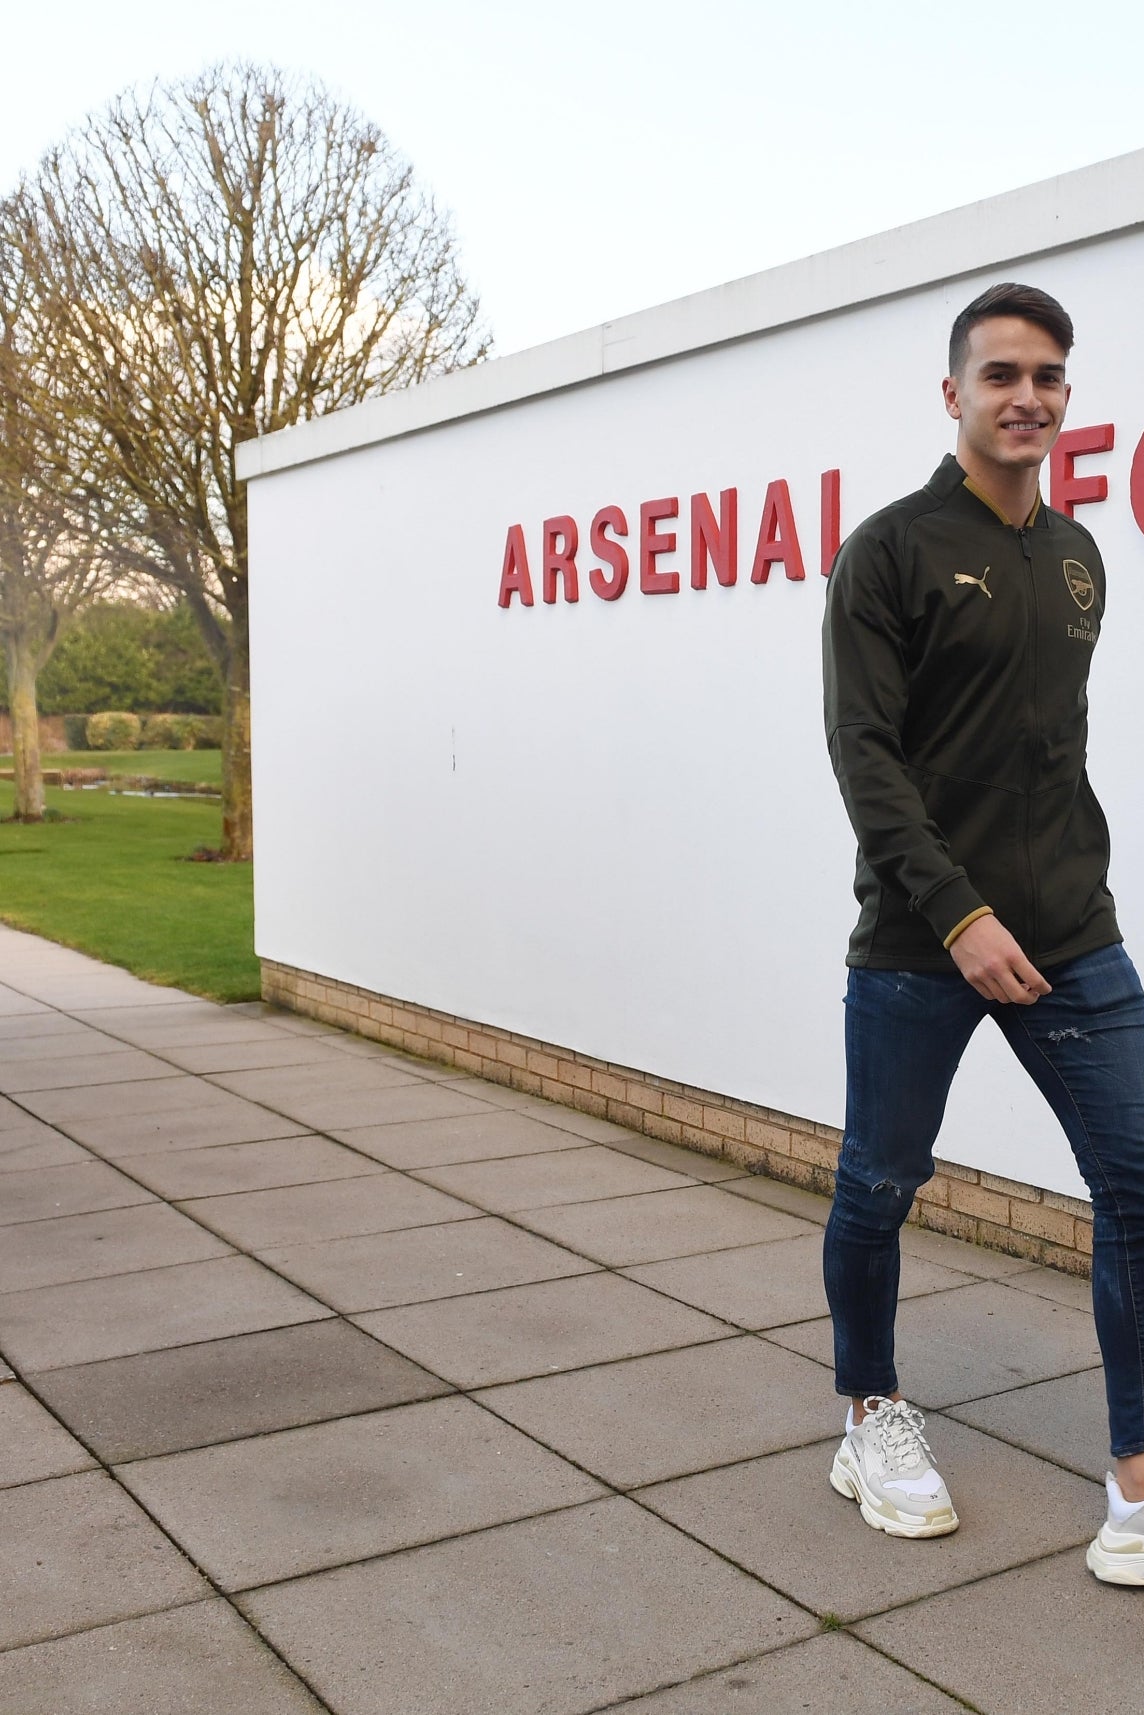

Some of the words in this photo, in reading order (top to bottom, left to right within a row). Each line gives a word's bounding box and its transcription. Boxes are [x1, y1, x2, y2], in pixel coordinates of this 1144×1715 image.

[498, 469, 841, 608] ARSENAL
[1079, 617, 1091, 630] Fly
[1067, 624, 1097, 645] Emirat
